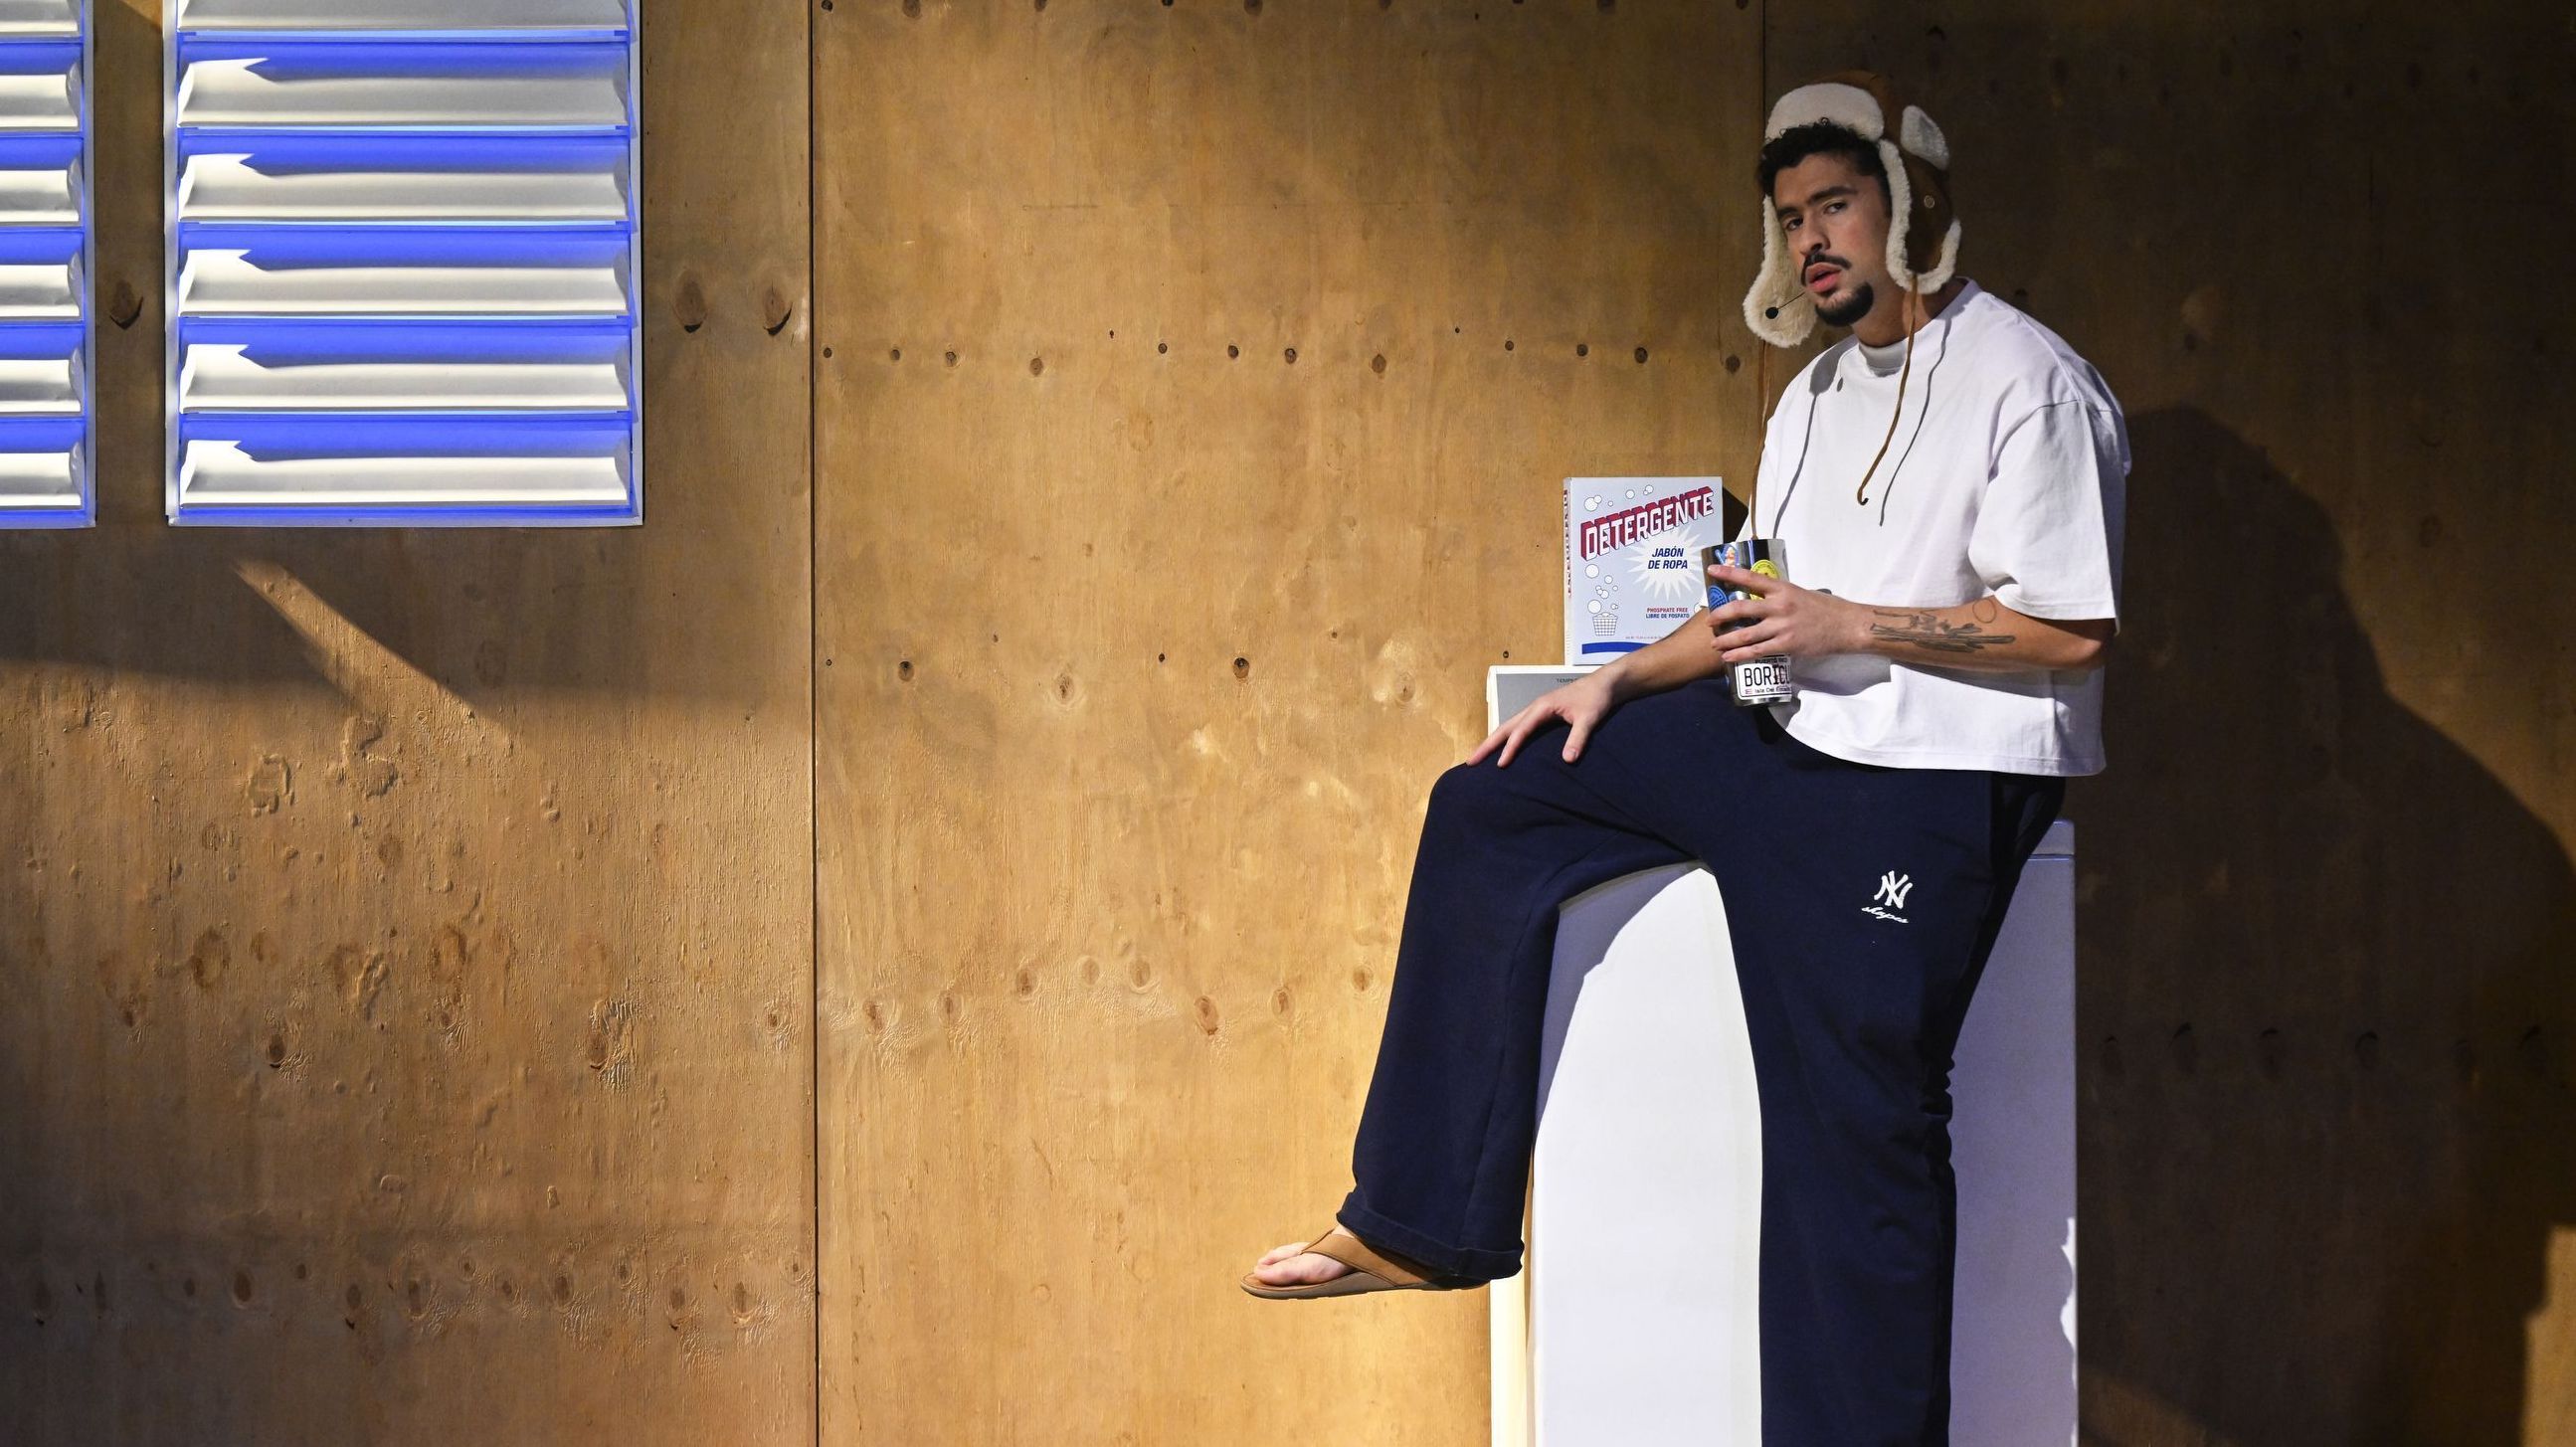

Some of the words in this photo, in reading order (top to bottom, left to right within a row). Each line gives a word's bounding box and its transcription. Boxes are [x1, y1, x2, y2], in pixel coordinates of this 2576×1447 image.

[1580, 486, 1714, 561] DETERGENTE
[1652, 545, 1684, 557] JABÓN
[1648, 560, 1660, 569] DE
[1663, 560, 1688, 569] ROPA
[1874, 870, 1914, 909] NY
